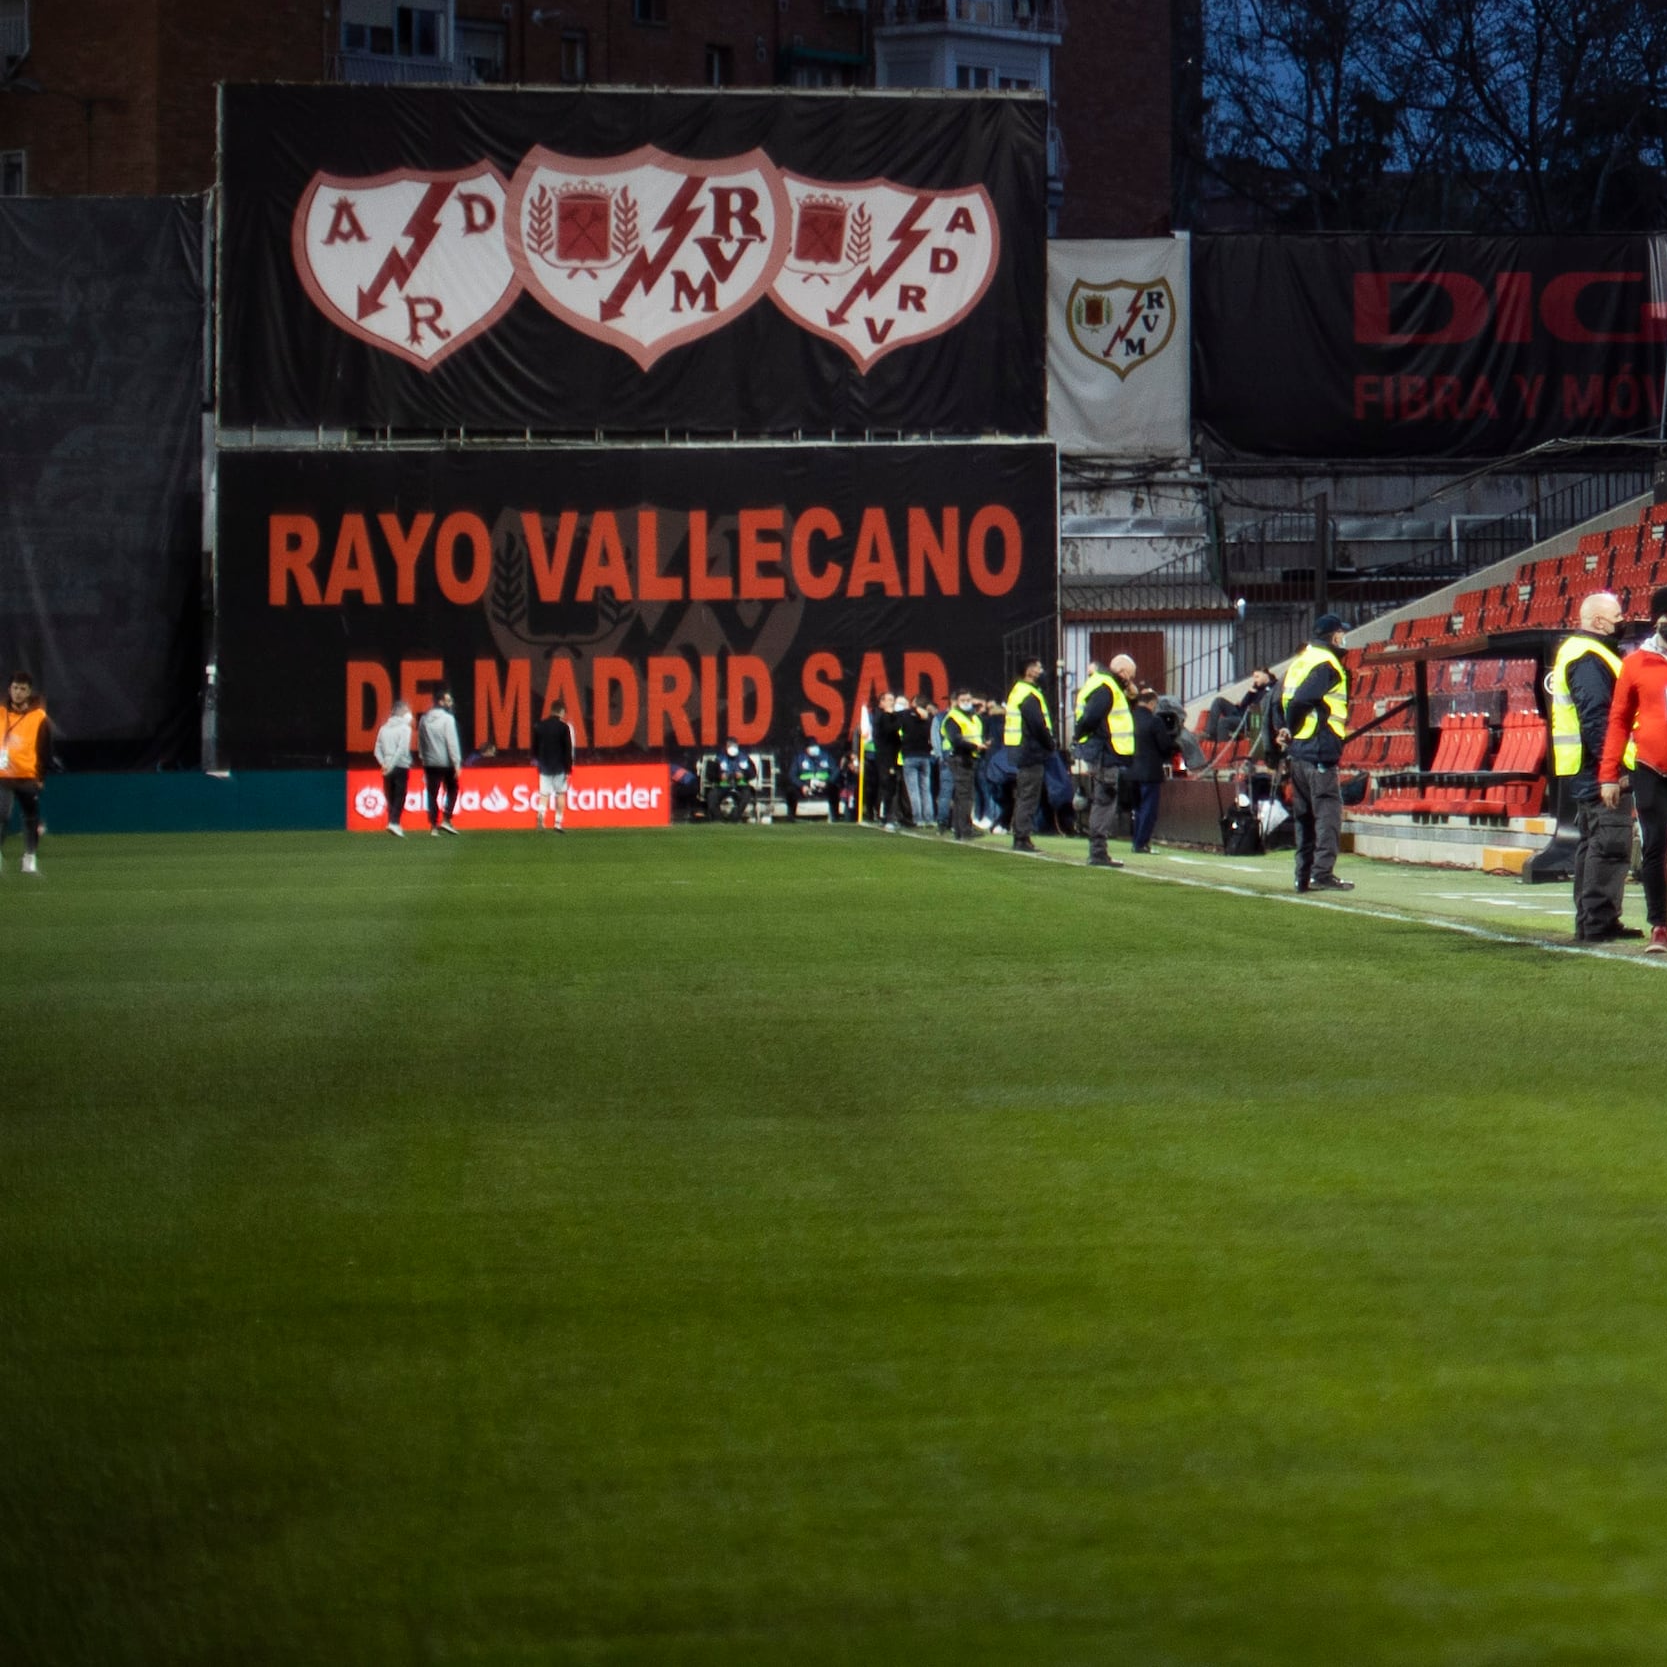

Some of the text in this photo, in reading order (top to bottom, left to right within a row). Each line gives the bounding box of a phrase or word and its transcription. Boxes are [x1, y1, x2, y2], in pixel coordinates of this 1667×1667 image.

[321, 190, 496, 246] A D
[709, 187, 767, 243] R
[946, 207, 975, 234] A
[694, 234, 753, 284] V
[929, 247, 958, 274] D
[670, 270, 720, 313] M
[897, 285, 926, 313] R
[1145, 291, 1164, 310] R
[402, 293, 452, 346] R
[865, 317, 896, 345] V
[1141, 315, 1160, 333] V
[1123, 337, 1145, 357] M
[1354, 375, 1498, 421] FIBRA
[1517, 375, 1546, 420] Y
[269, 504, 1023, 606] RAYO VALLECANO
[474, 655, 774, 751] MADRID
